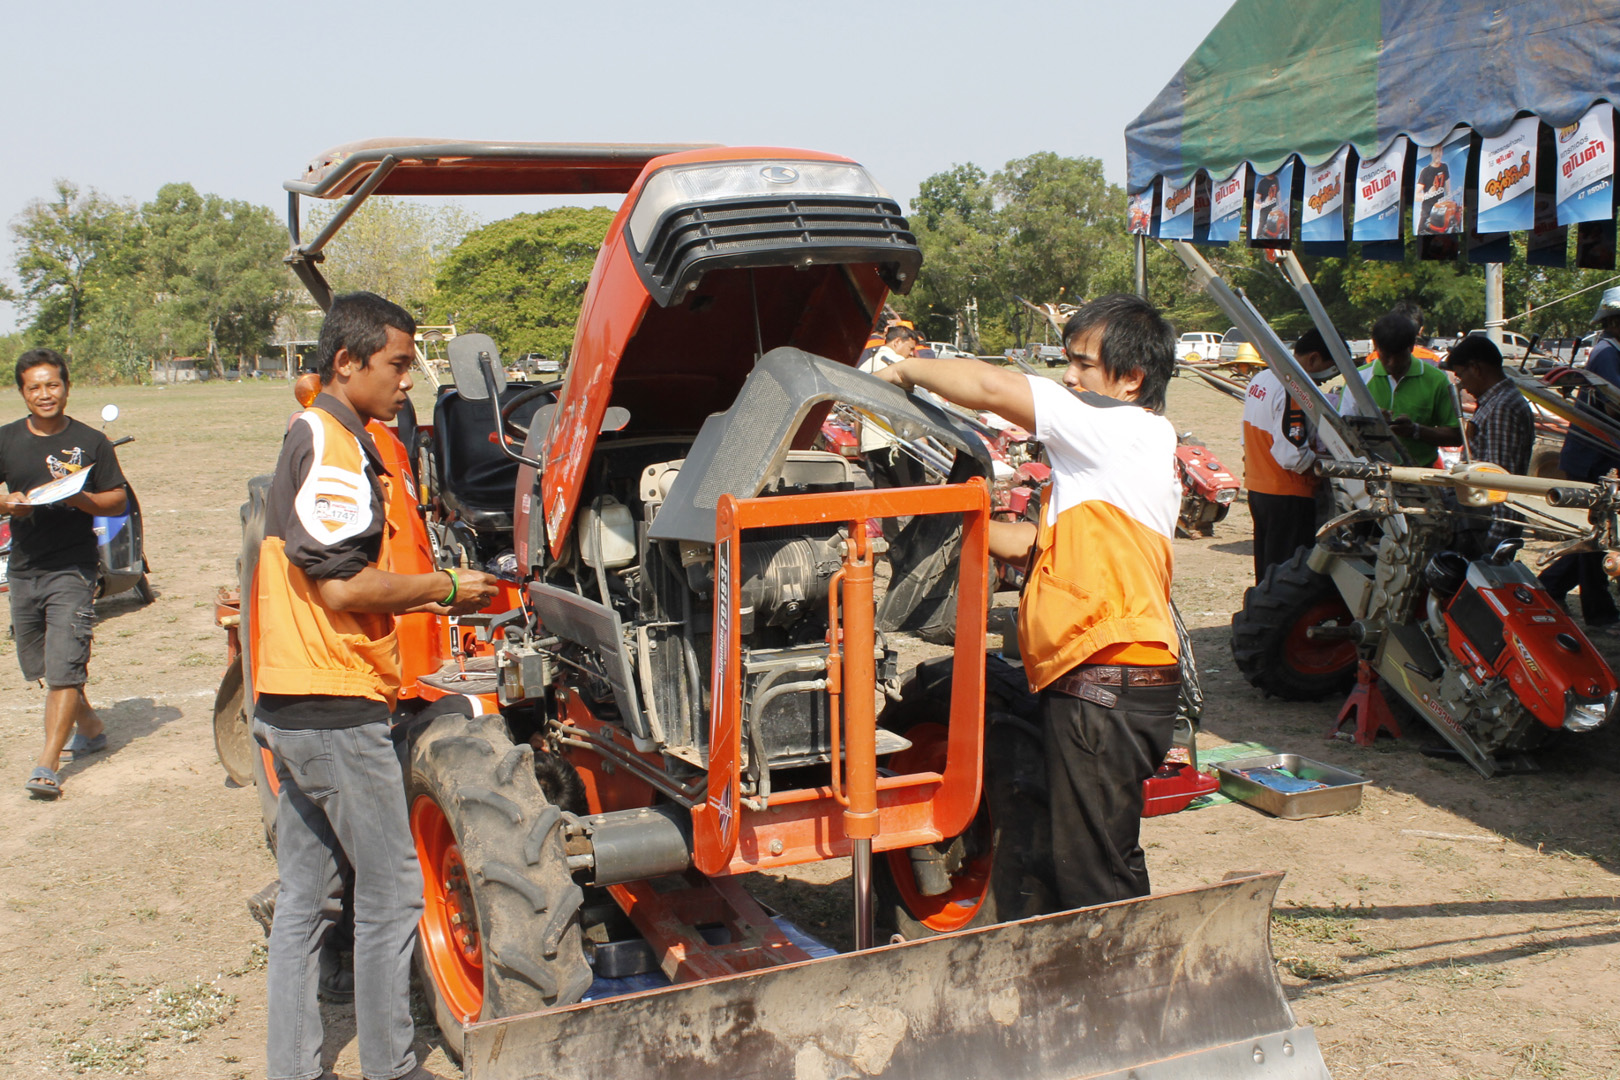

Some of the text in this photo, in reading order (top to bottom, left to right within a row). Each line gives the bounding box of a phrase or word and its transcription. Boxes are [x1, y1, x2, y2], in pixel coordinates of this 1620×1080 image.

[1562, 139, 1606, 178] คูโบต้า
[1215, 179, 1240, 204] คูโบต้า
[1362, 169, 1397, 200] คูโบต้า
[332, 510, 356, 521] 1747
